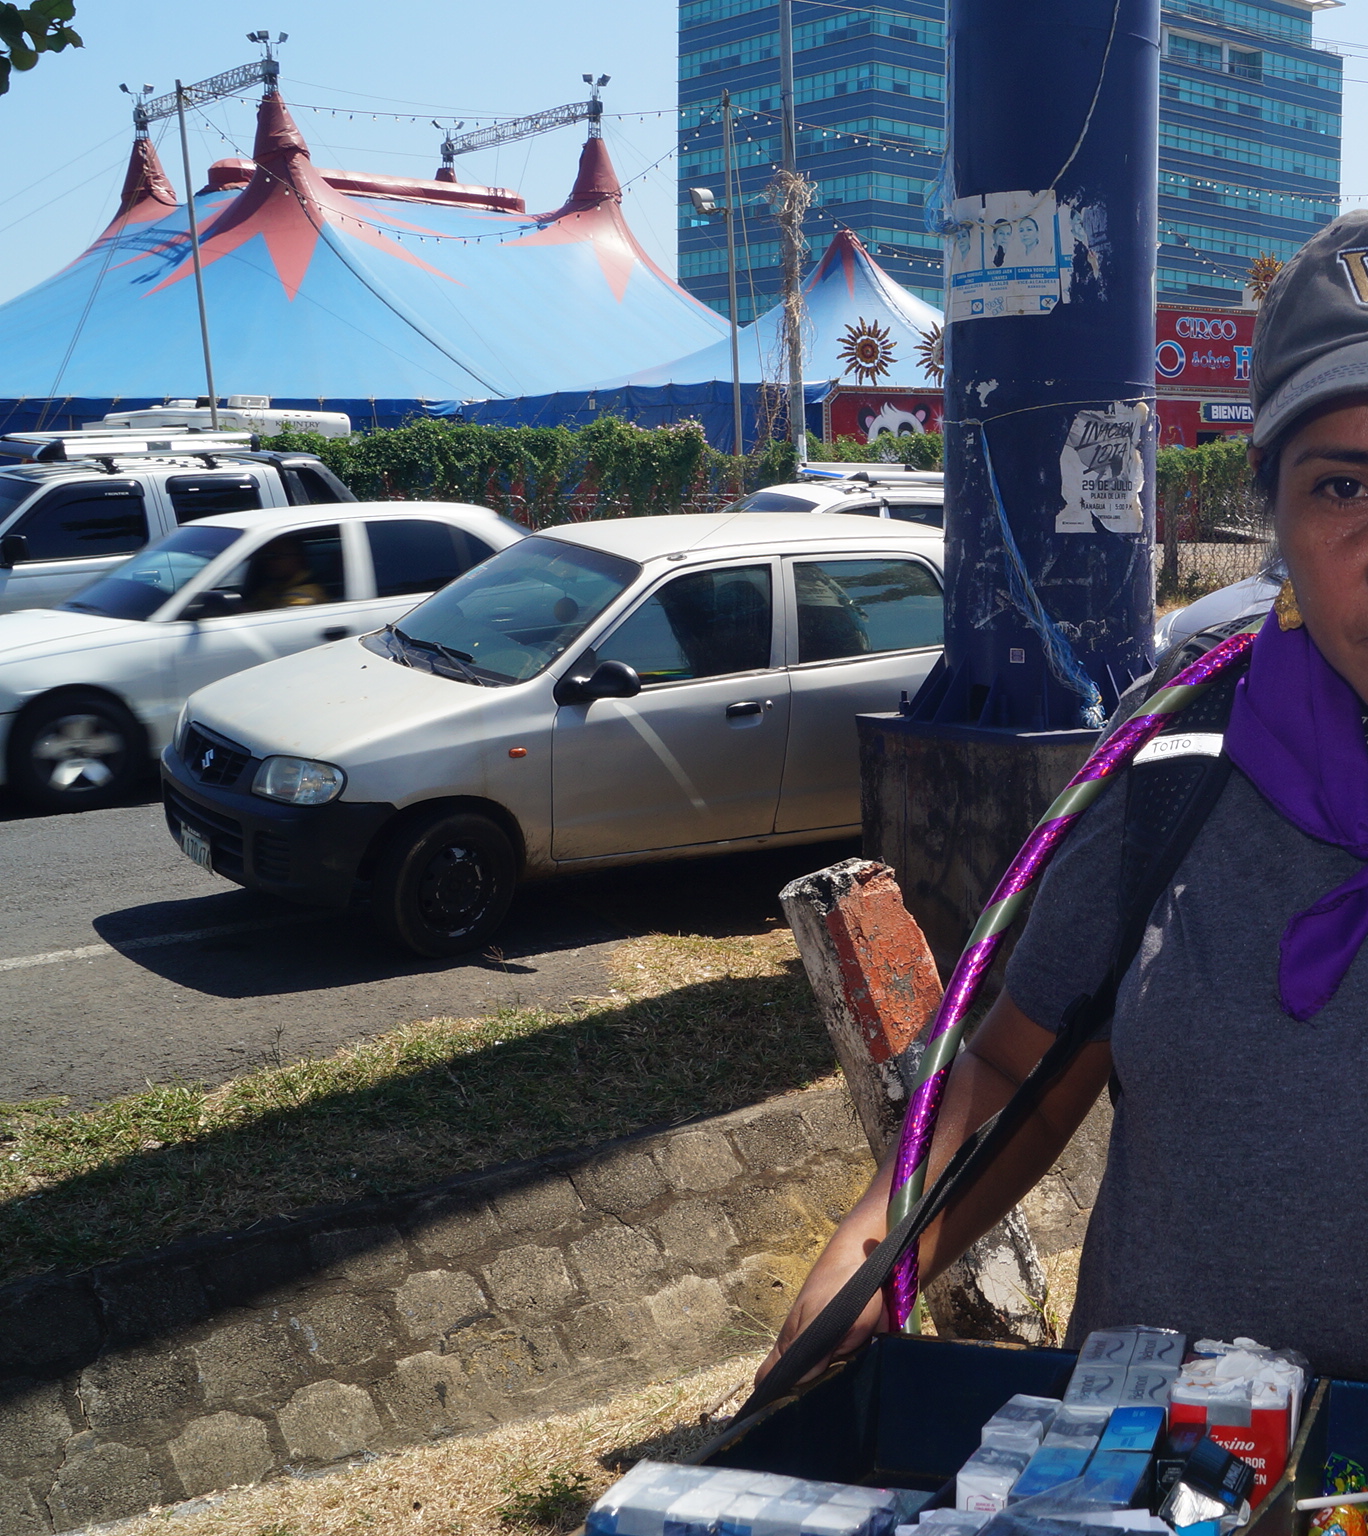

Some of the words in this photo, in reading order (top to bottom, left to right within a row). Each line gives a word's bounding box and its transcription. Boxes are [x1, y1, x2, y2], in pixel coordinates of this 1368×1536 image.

[1175, 316, 1237, 341] CIRCO
[1191, 350, 1231, 369] sobre
[1082, 480, 1095, 491] 29
[1097, 480, 1109, 491] DE
[1111, 480, 1133, 491] JULIO
[1152, 739, 1192, 753] TOTTO
[1127, 1374, 1149, 1400] Belmont
